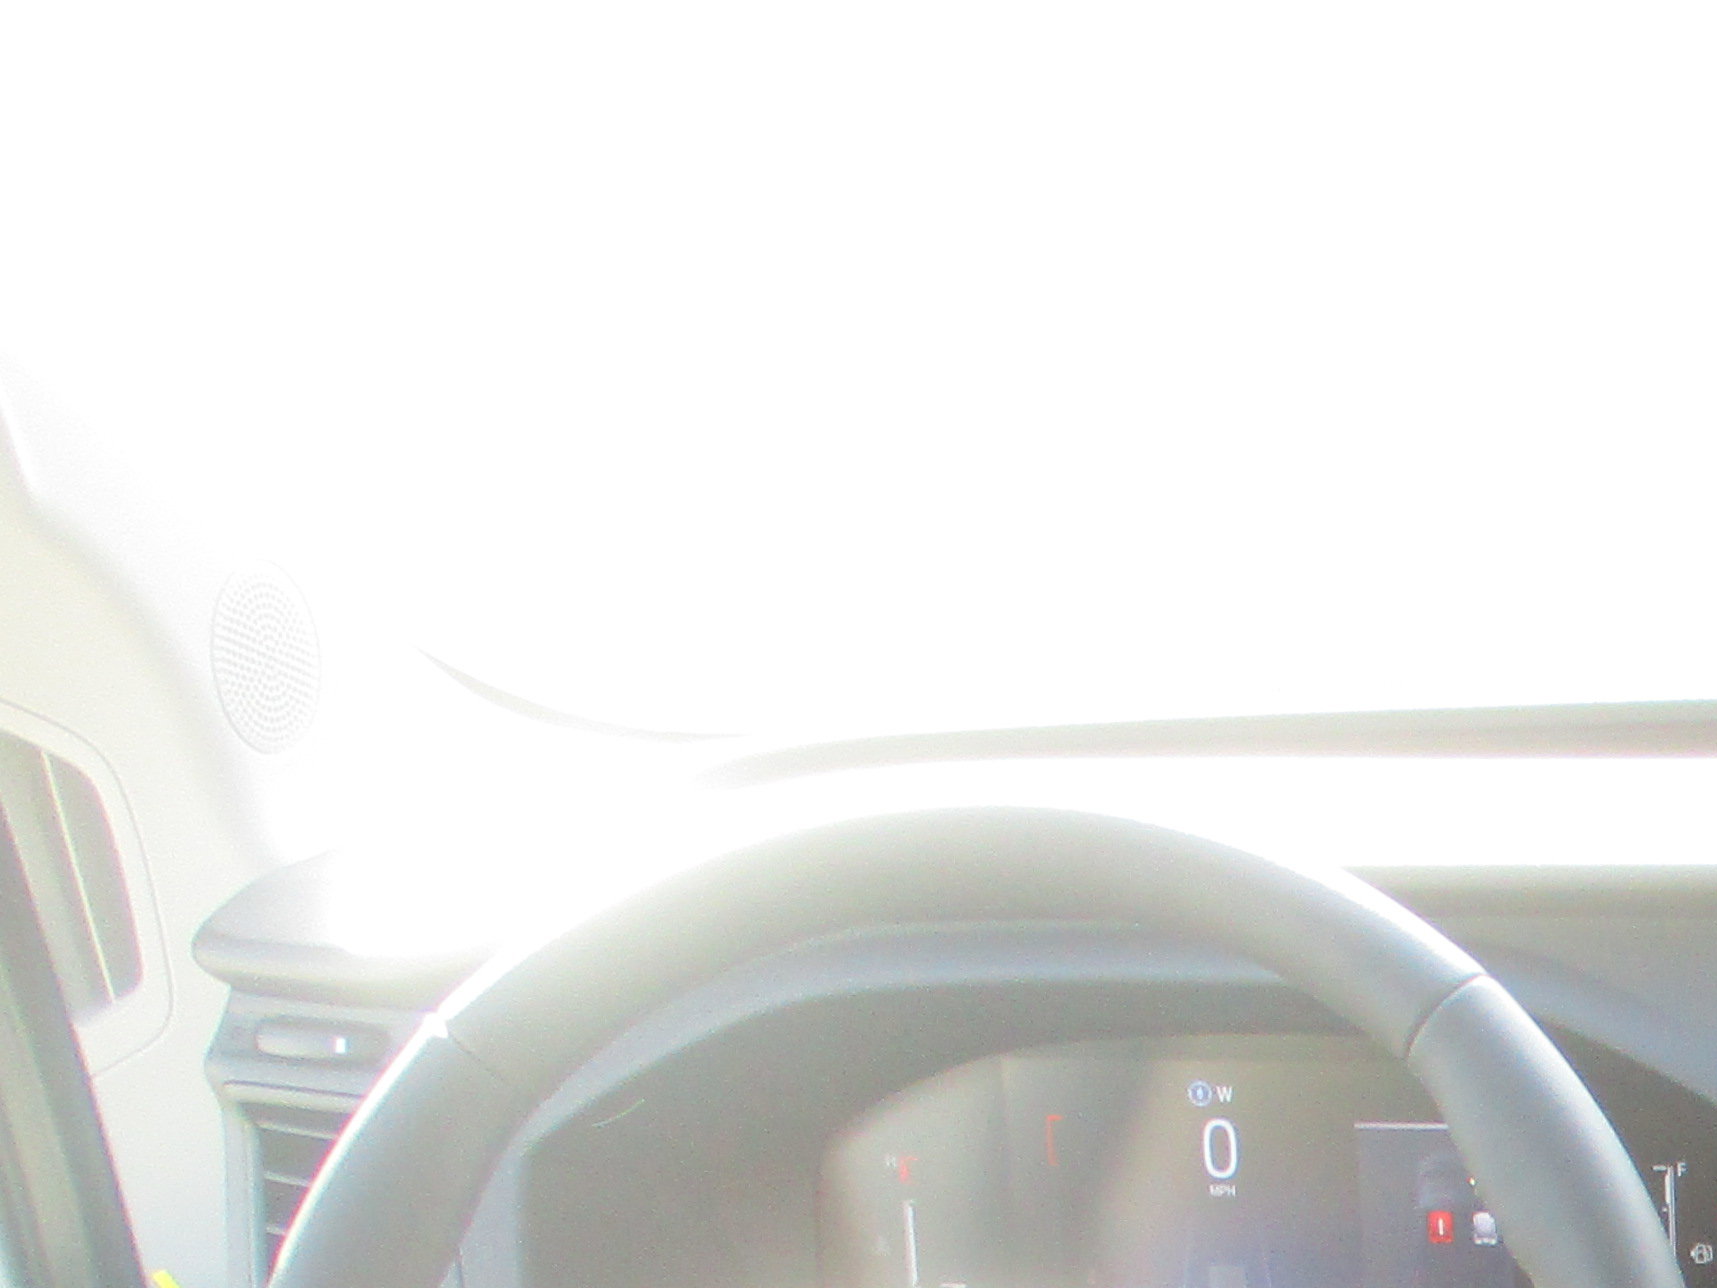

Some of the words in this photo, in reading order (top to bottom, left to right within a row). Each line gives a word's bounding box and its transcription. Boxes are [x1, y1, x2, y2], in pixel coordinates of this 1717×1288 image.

[1216, 1086, 1234, 1103] W
[1202, 1116, 1240, 1181] 0
[1677, 1161, 1688, 1177] F
[1209, 1184, 1237, 1198] MPH
